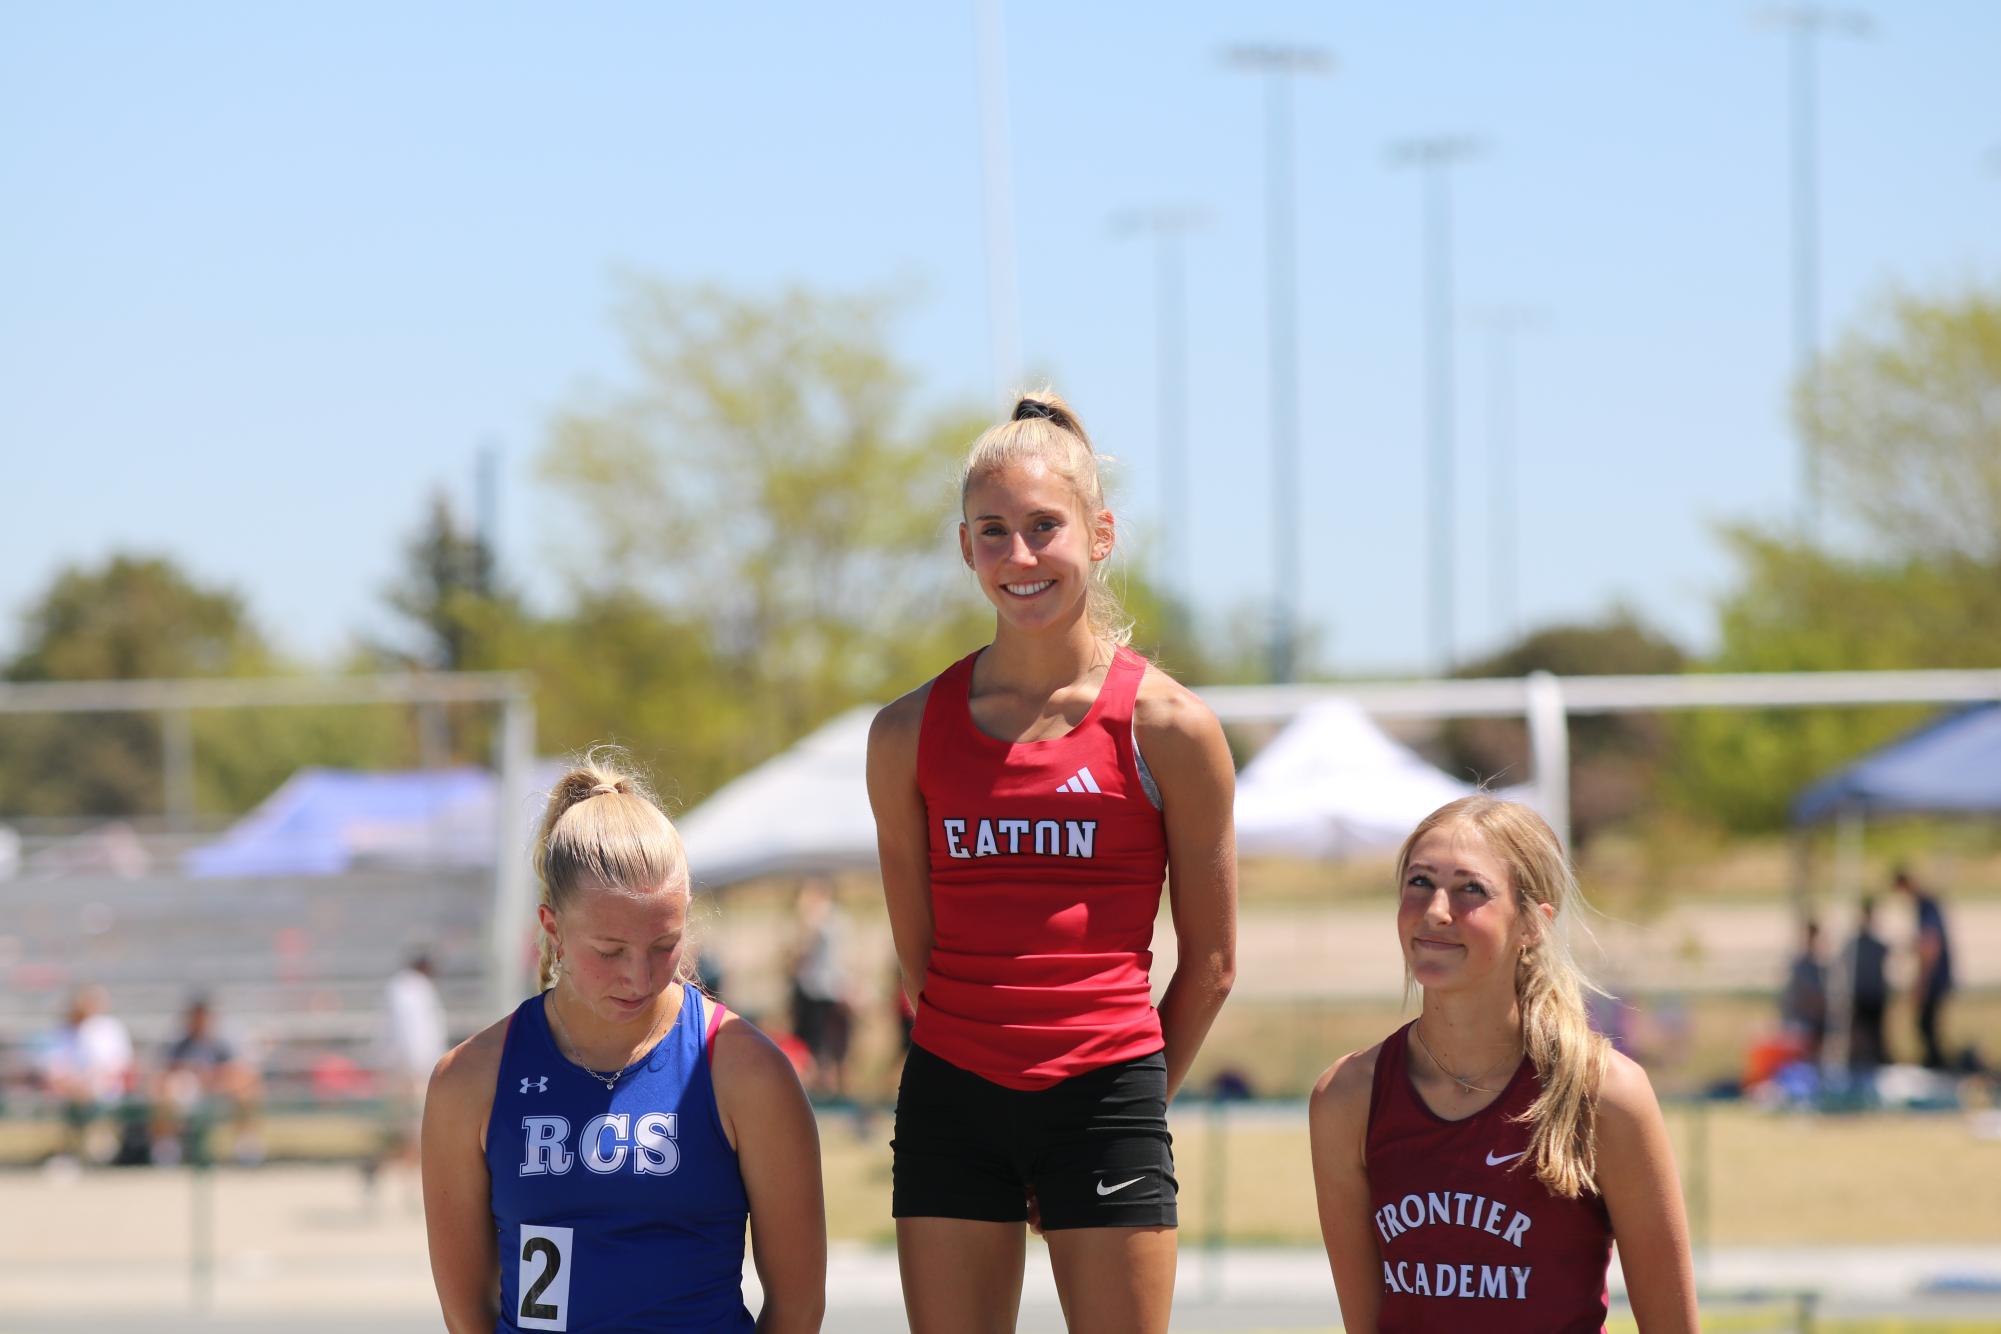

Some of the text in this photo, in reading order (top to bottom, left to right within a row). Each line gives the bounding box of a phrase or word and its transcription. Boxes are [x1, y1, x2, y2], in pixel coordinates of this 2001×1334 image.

[942, 818, 1098, 860] EATON
[519, 1113, 681, 1177] RCS
[1375, 1191, 1532, 1248] FRONTIER
[520, 1236, 562, 1321] 2
[1383, 1261, 1532, 1300] ACADEMY
